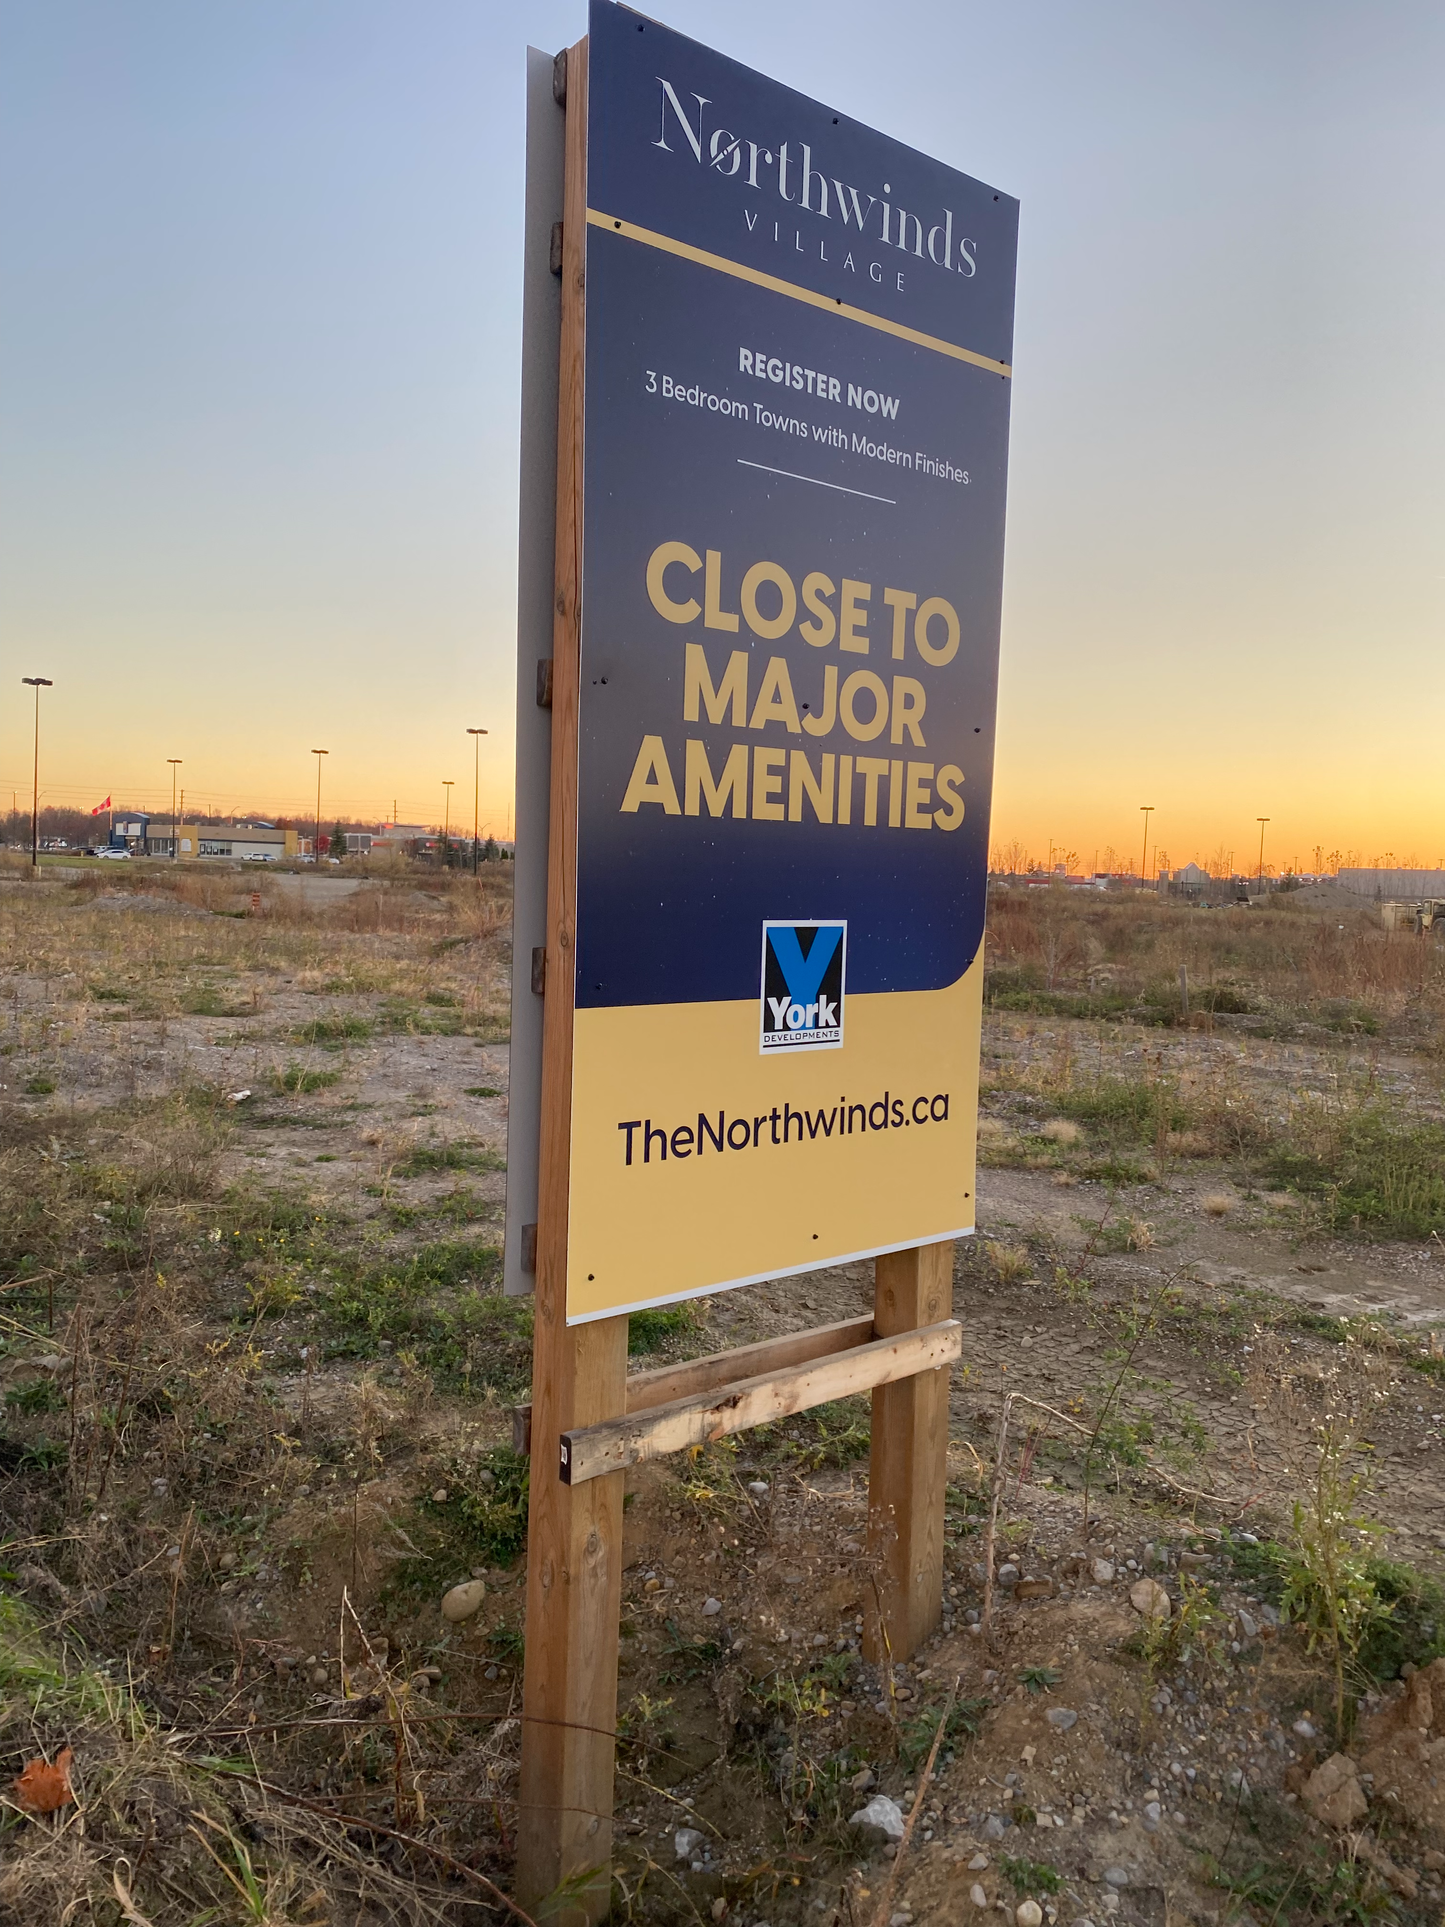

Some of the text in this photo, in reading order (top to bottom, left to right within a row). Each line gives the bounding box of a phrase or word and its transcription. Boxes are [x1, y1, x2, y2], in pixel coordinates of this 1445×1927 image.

[744, 209, 905, 293] VILLAGE
[739, 346, 900, 420] REGISTER NOW
[645, 370, 970, 485] 3 Bedroom Towns with Modern Finishes
[646, 541, 961, 667] CLOSE TO
[683, 642, 927, 748] MAJOR
[619, 734, 966, 832] AMENITIES
[763, 1030, 840, 1043] DEVELOPMENTS
[766, 994, 839, 1030] York
[617, 1091, 950, 1167] TheNorthwinds.ca
